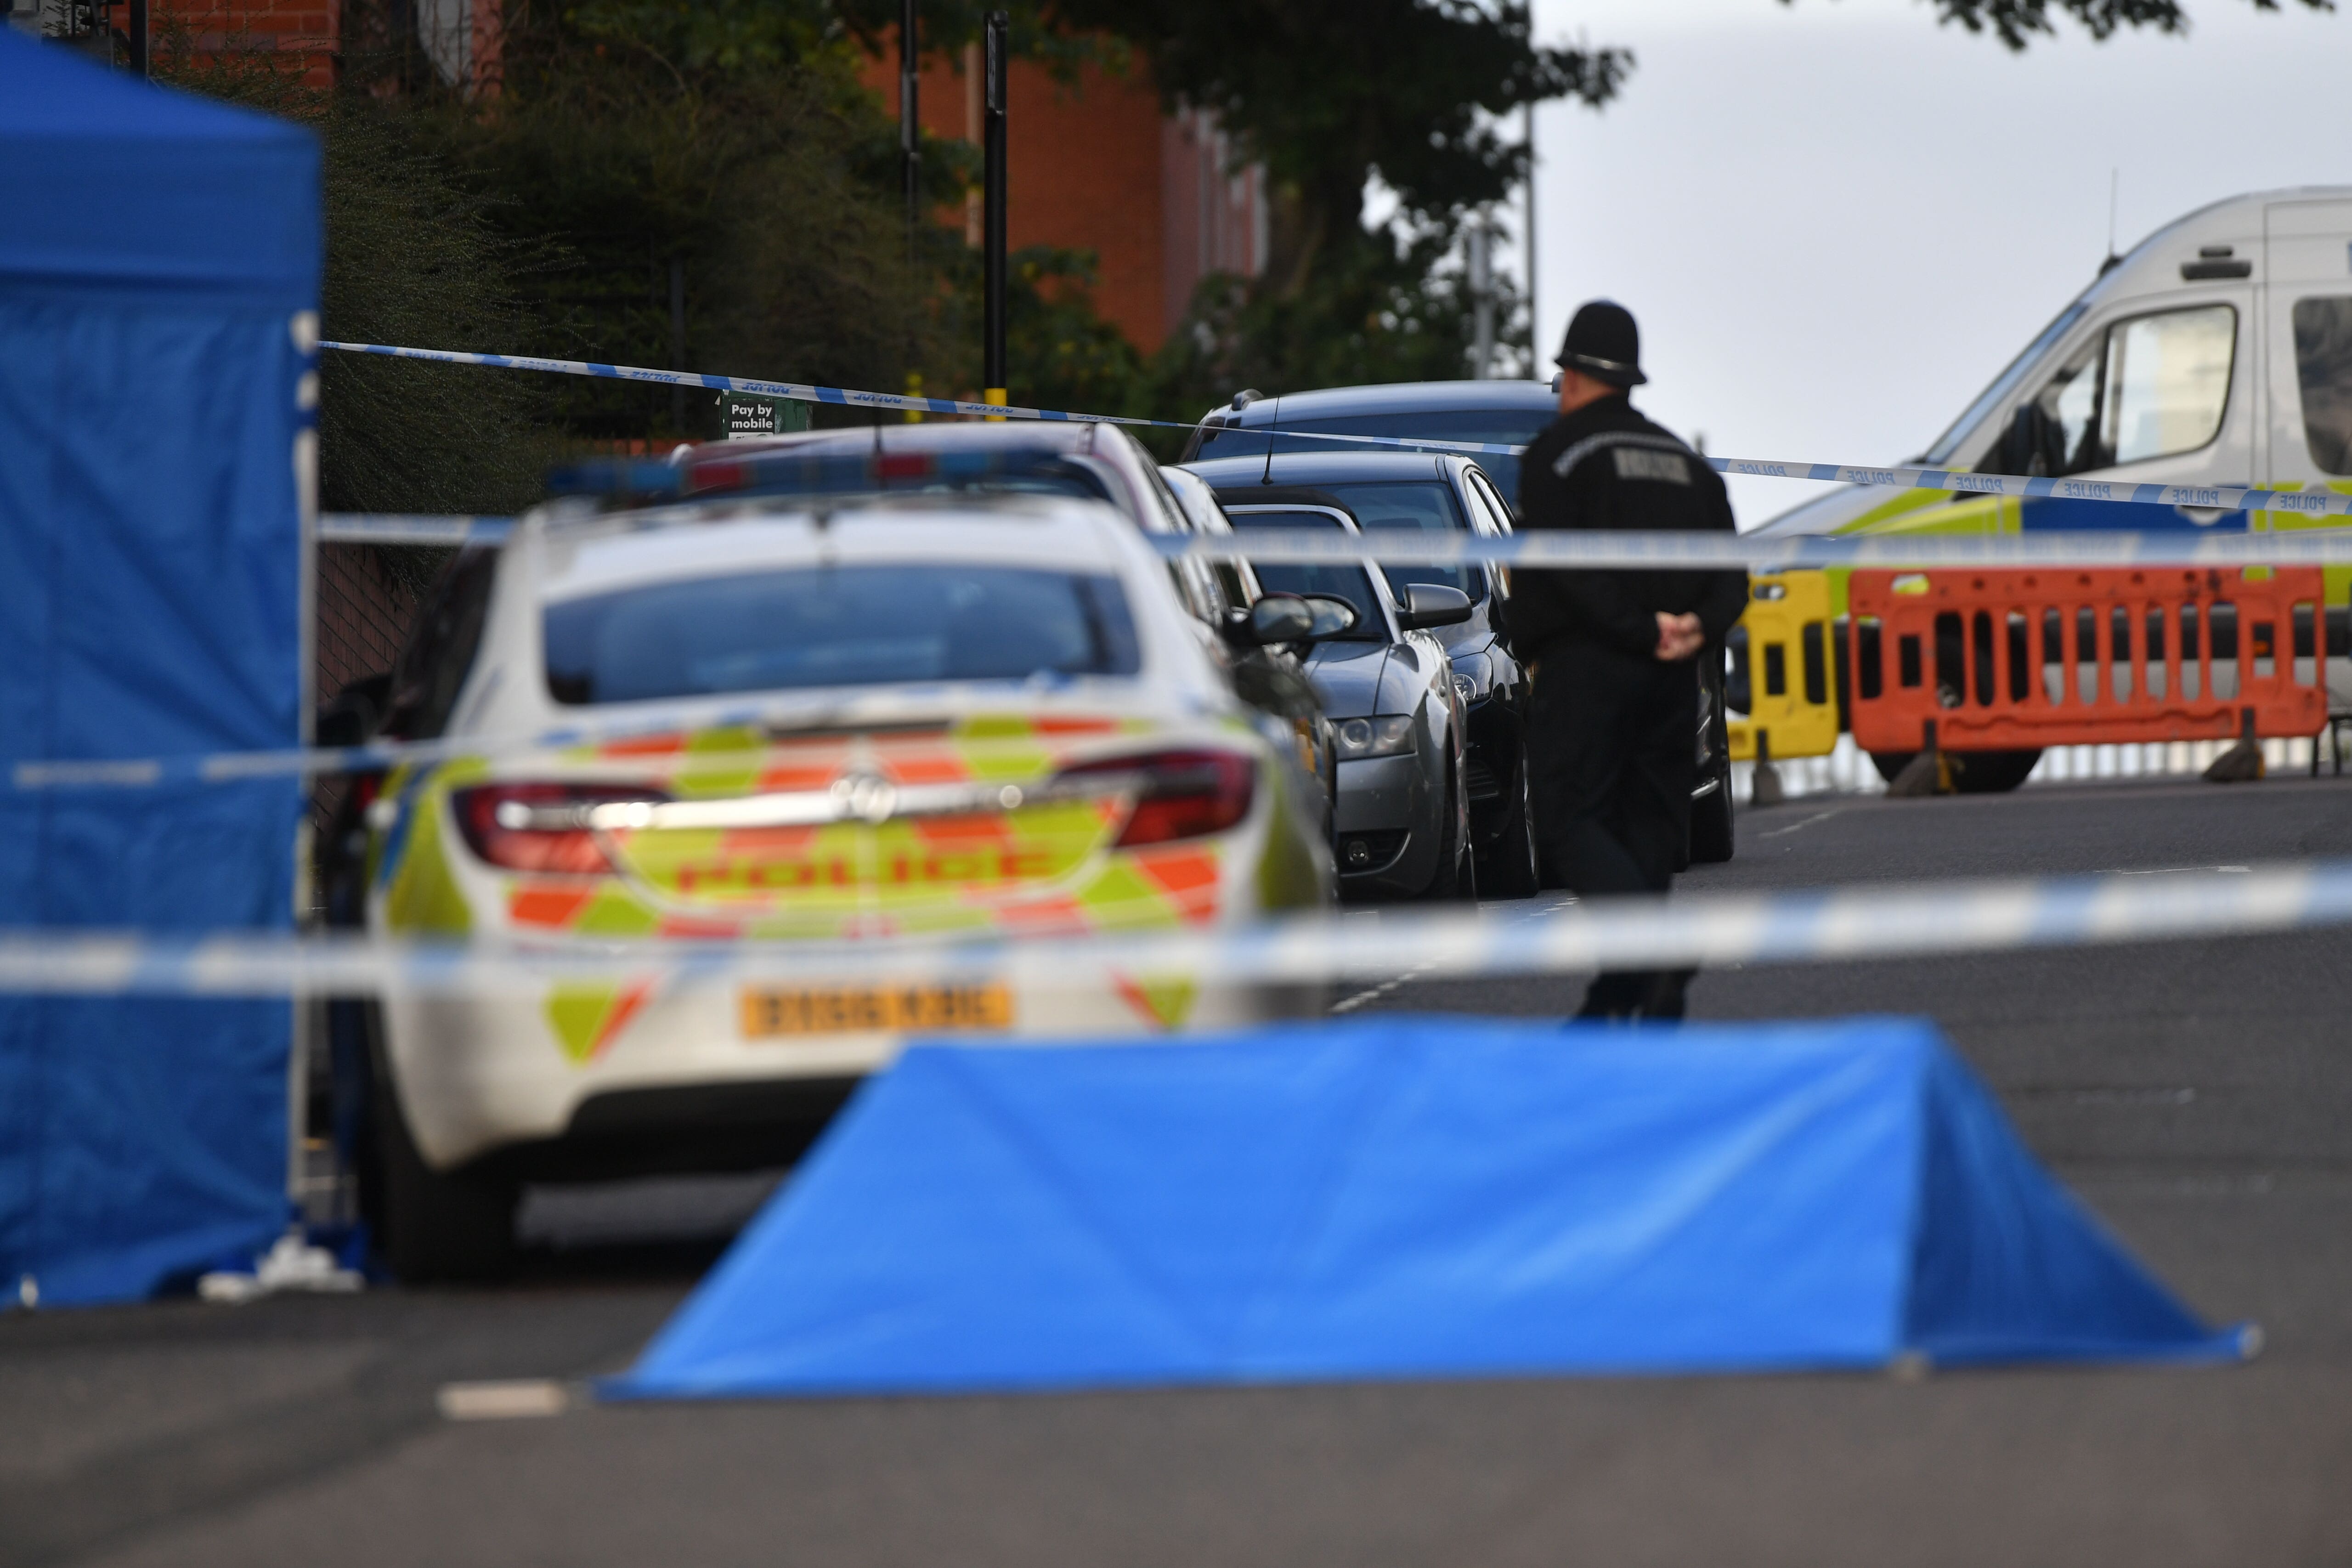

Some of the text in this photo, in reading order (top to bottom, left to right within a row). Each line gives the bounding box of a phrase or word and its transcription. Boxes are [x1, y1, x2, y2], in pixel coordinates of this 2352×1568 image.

[731, 404, 772, 417] Pay by
[731, 418, 773, 428] mobile
